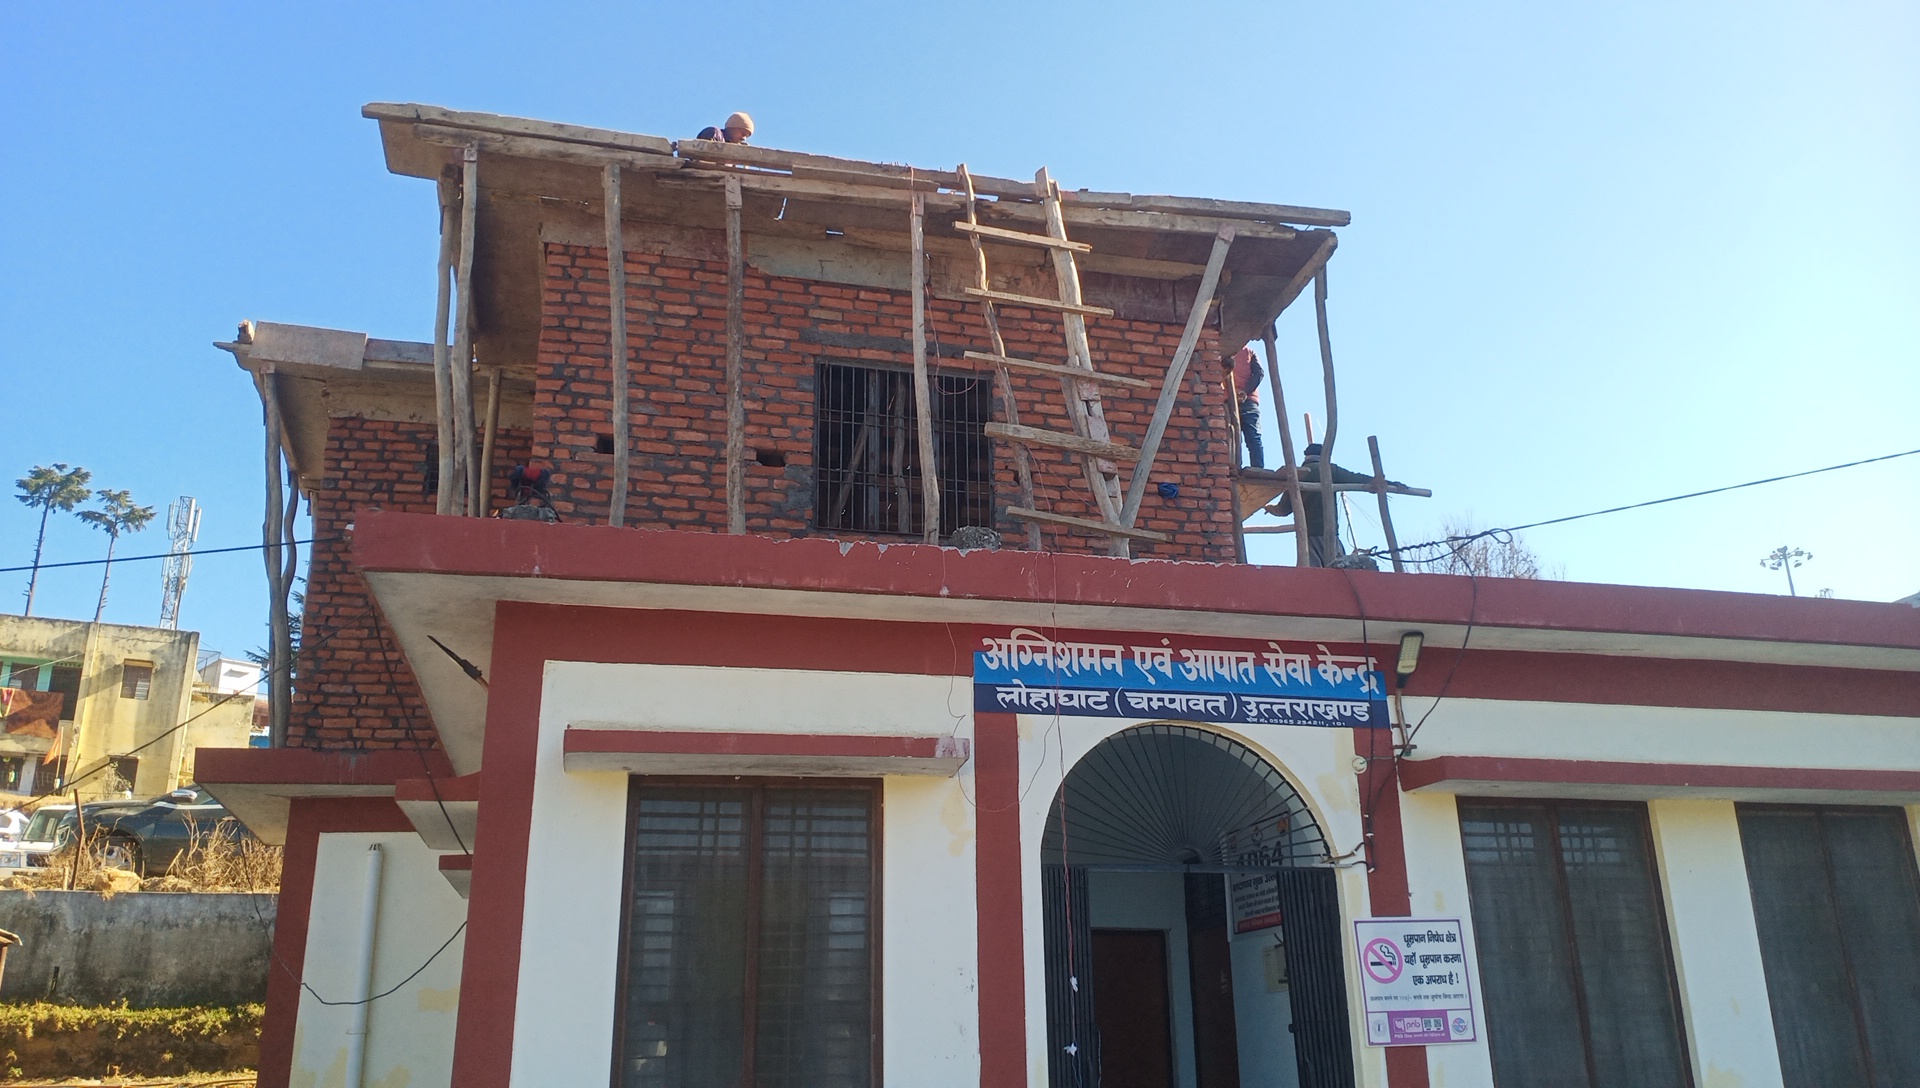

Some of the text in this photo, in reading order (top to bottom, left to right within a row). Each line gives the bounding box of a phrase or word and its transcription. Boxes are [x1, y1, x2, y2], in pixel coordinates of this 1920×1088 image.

[981, 627, 1380, 695] अग्निशमन एवं आपात सेवा केन्द्र
[995, 678, 1371, 722] लोहाघाट (चम्पावत) उत्तराखण्ड
[1427, 930, 1445, 944] निषेध
[1445, 930, 1457, 943] क्षेत्र
[1443, 953, 1462, 964] करना
[1412, 974, 1424, 986] एक
[1425, 973, 1448, 985] अपराध
[1405, 1019, 1421, 1031] pnb
